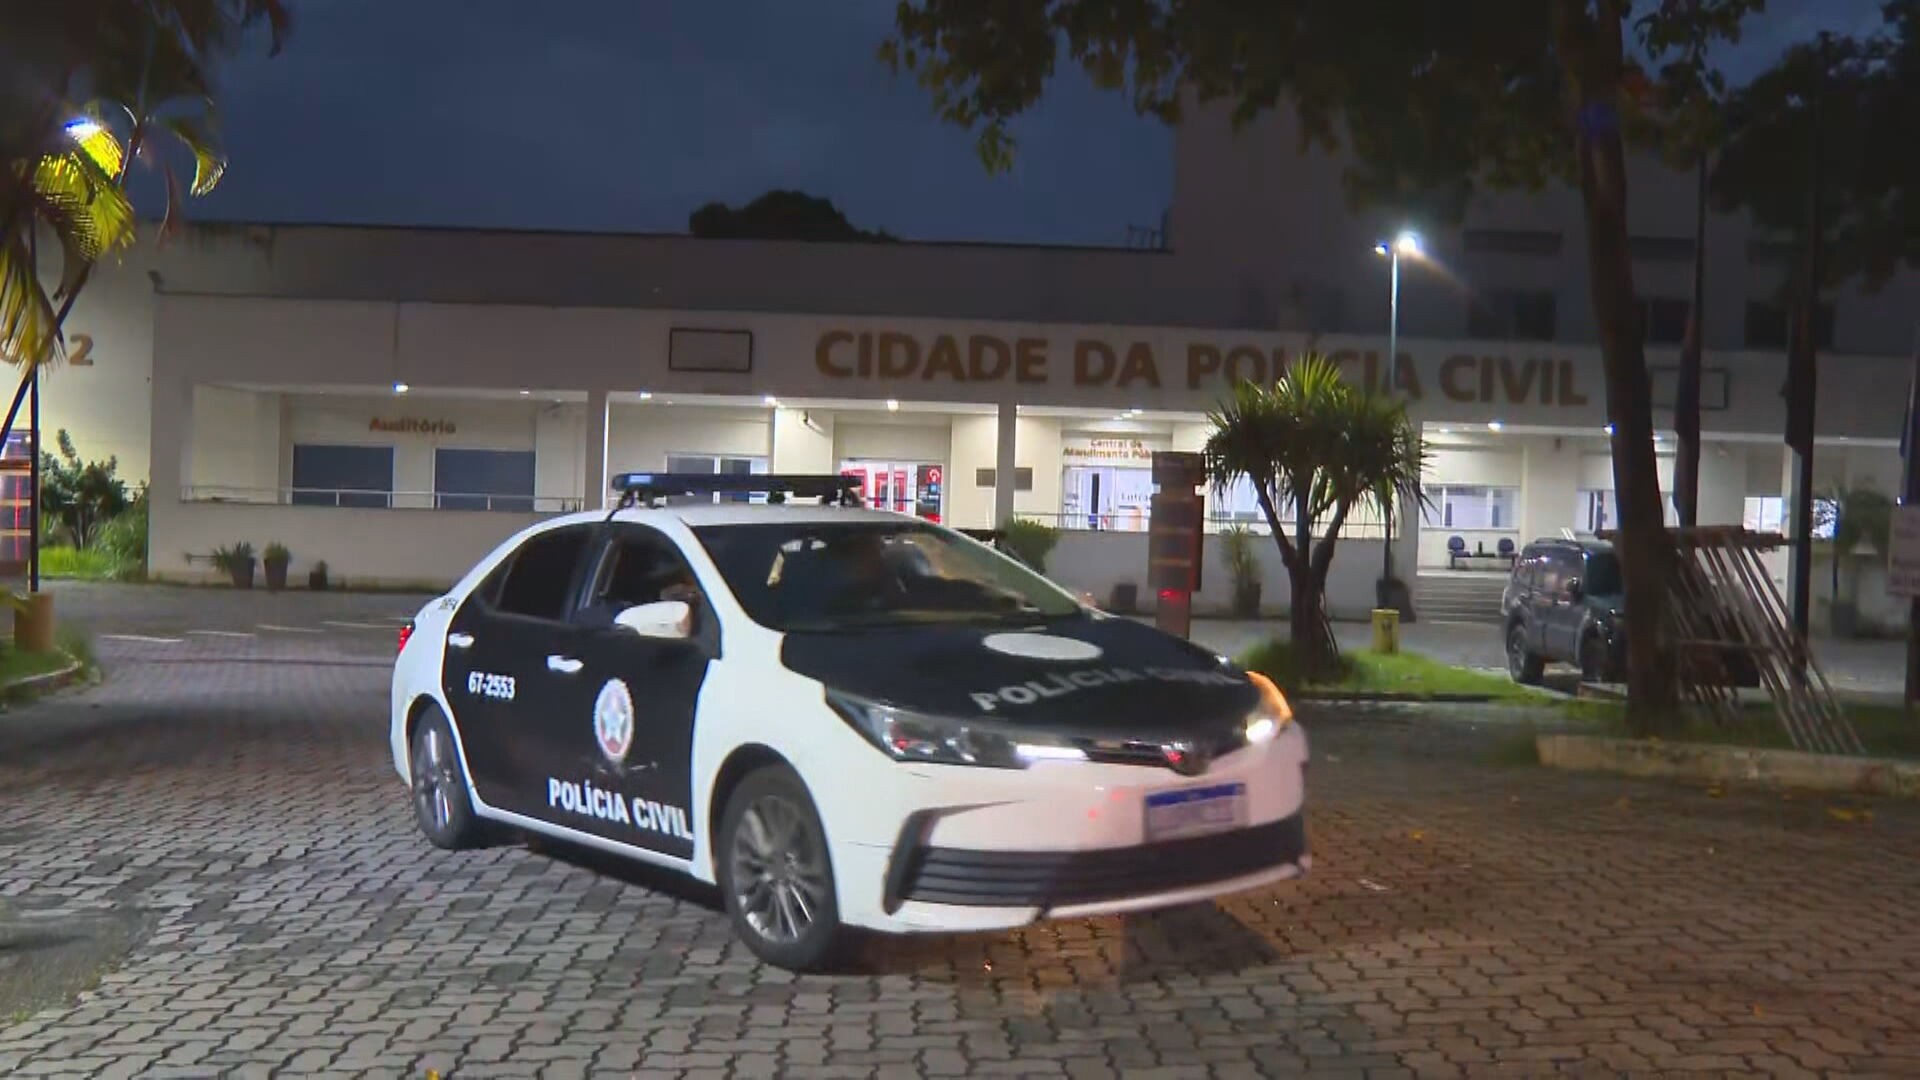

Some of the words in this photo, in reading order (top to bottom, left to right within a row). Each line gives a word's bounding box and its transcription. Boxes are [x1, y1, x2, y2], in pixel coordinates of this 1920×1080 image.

[69, 333, 94, 366] 2
[814, 329, 1049, 384] CIDADE
[1073, 339, 1161, 389] DA
[1438, 354, 1588, 406] CIVIL
[368, 416, 456, 434] Auditório
[1063, 447, 1129, 459] Atendimento
[1091, 439, 1128, 448] Central
[468, 671, 515, 700] 67-2553
[549, 778, 630, 824] POLÍCIA
[632, 797, 694, 841] CIVIL
